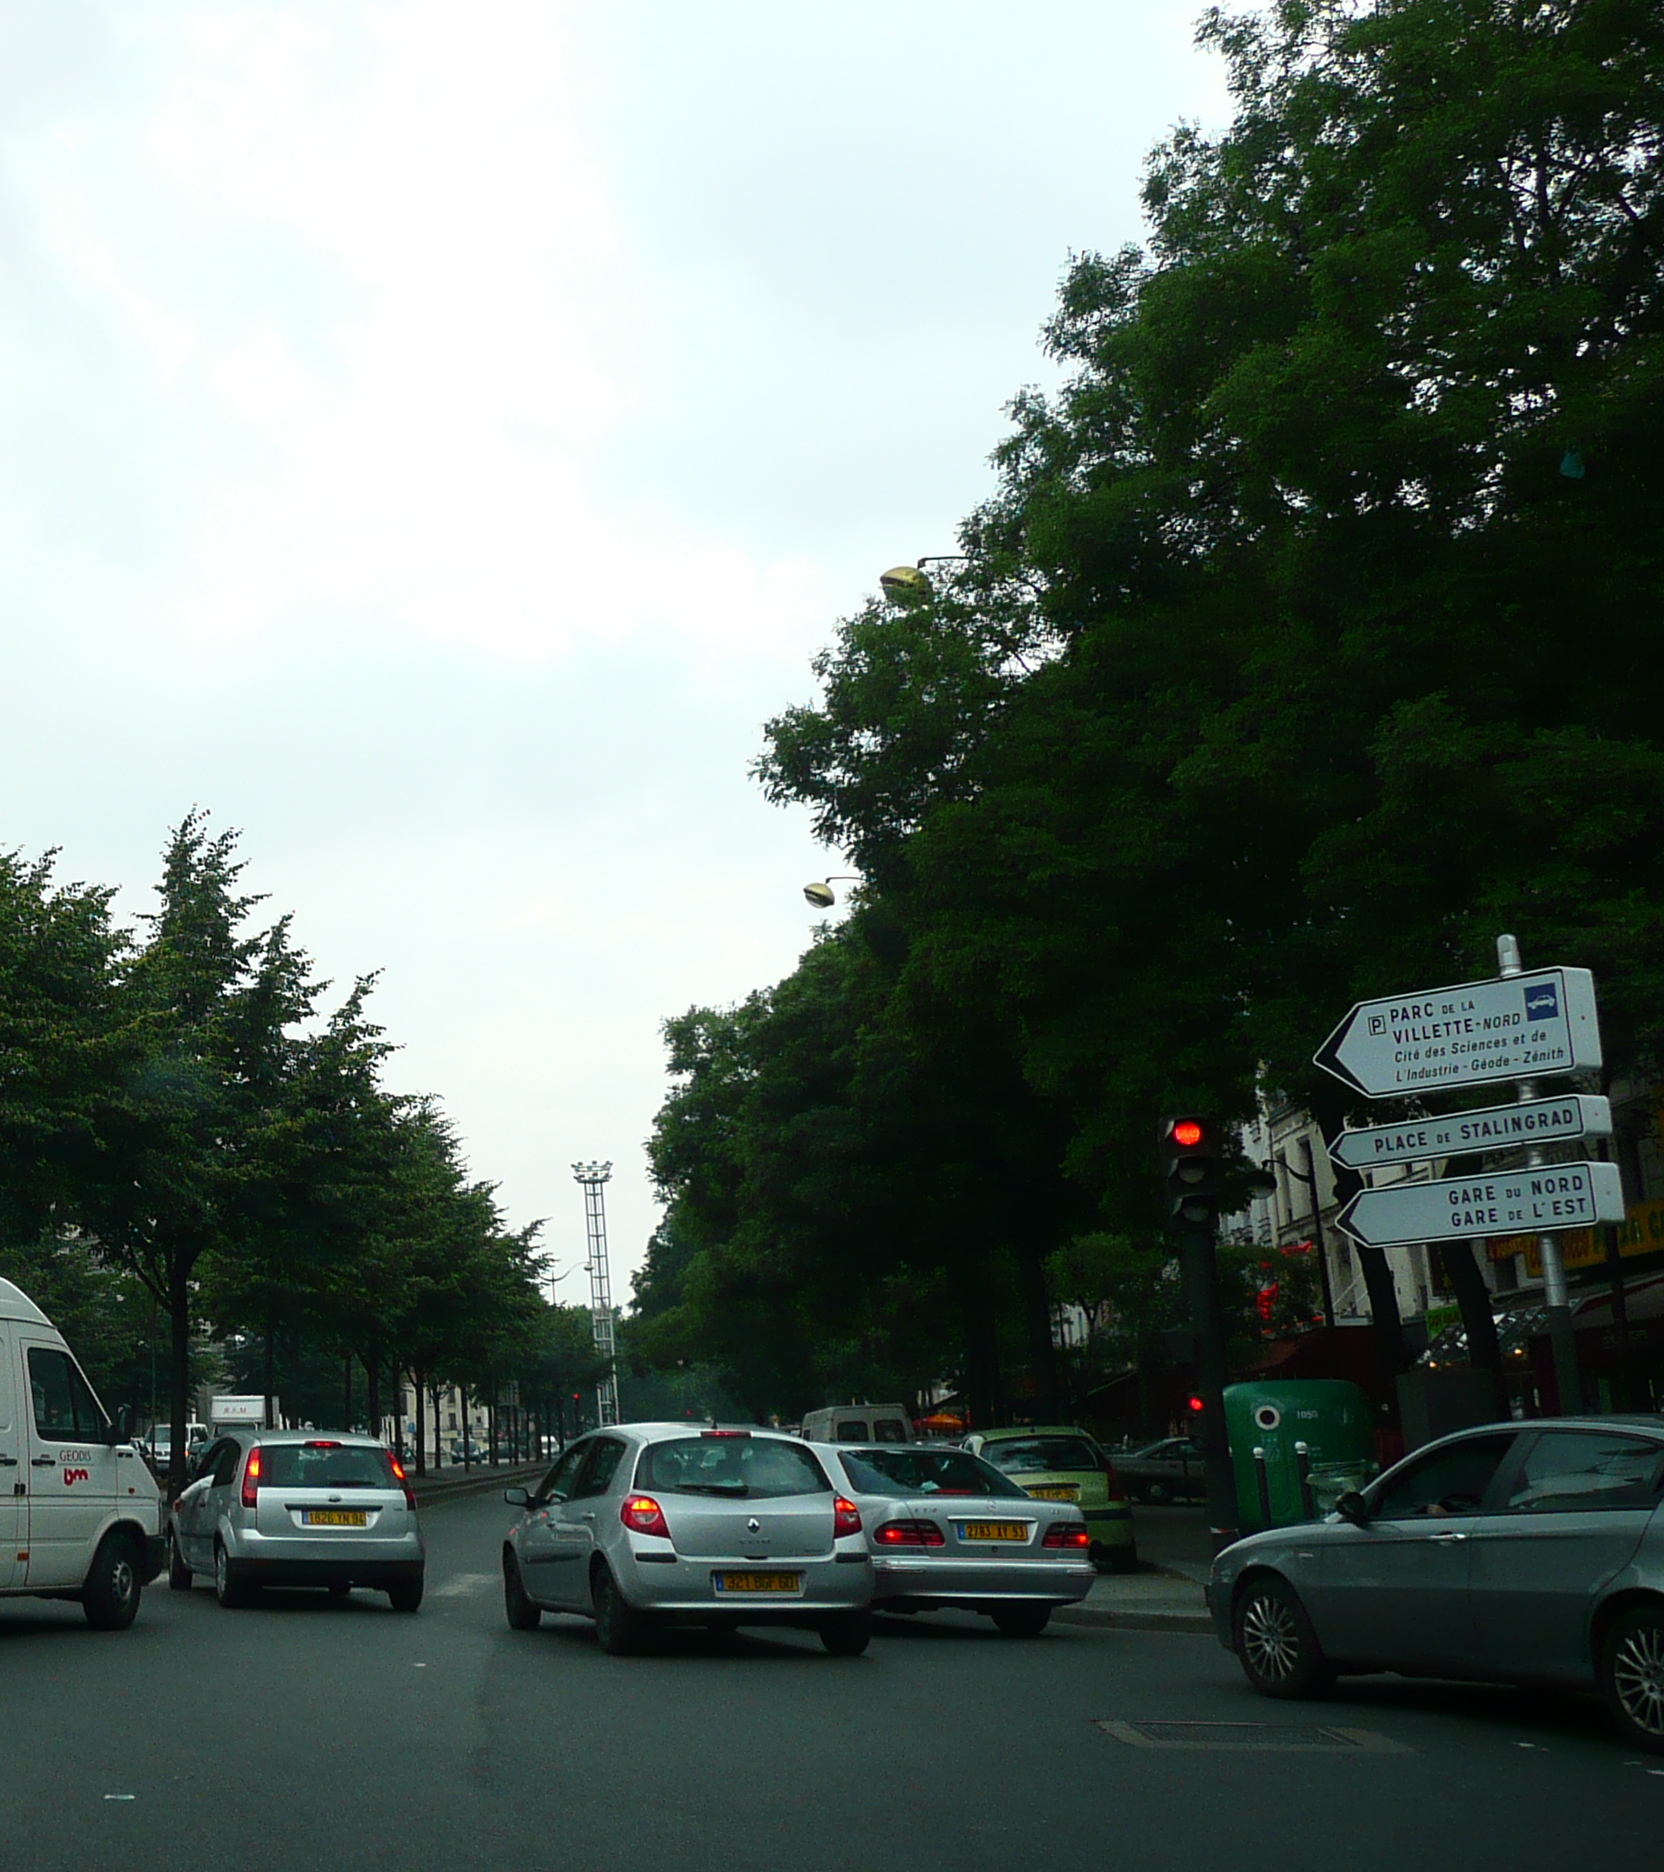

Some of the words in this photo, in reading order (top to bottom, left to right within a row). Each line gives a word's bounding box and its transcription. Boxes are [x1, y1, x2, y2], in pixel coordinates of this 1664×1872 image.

[1389, 1003, 1434, 1023] PARC
[1441, 1004, 1455, 1015] DE
[1461, 1001, 1475, 1012] LA
[1394, 1048, 1420, 1063] Cité
[1425, 1045, 1446, 1059] des
[1451, 1037, 1507, 1055] Sciences
[1513, 1033, 1525, 1045] et
[1531, 1030, 1547, 1042] de
[1396, 1064, 1459, 1082] L'Industrie
[1471, 1055, 1510, 1071] Géode
[1523, 1047, 1564, 1064] Zénith
[1374, 1132, 1427, 1153] PLACE
[1437, 1132, 1451, 1144] DE
[1460, 1109, 1573, 1140] STALINGRAD
[1448, 1186, 1496, 1205] GARE
[1506, 1188, 1521, 1198] DU
[1531, 1175, 1583, 1196] NORD
[1451, 1208, 1498, 1227] GARE
[1508, 1209, 1523, 1220] DE
[59, 1450, 91, 1462] GEODIS
